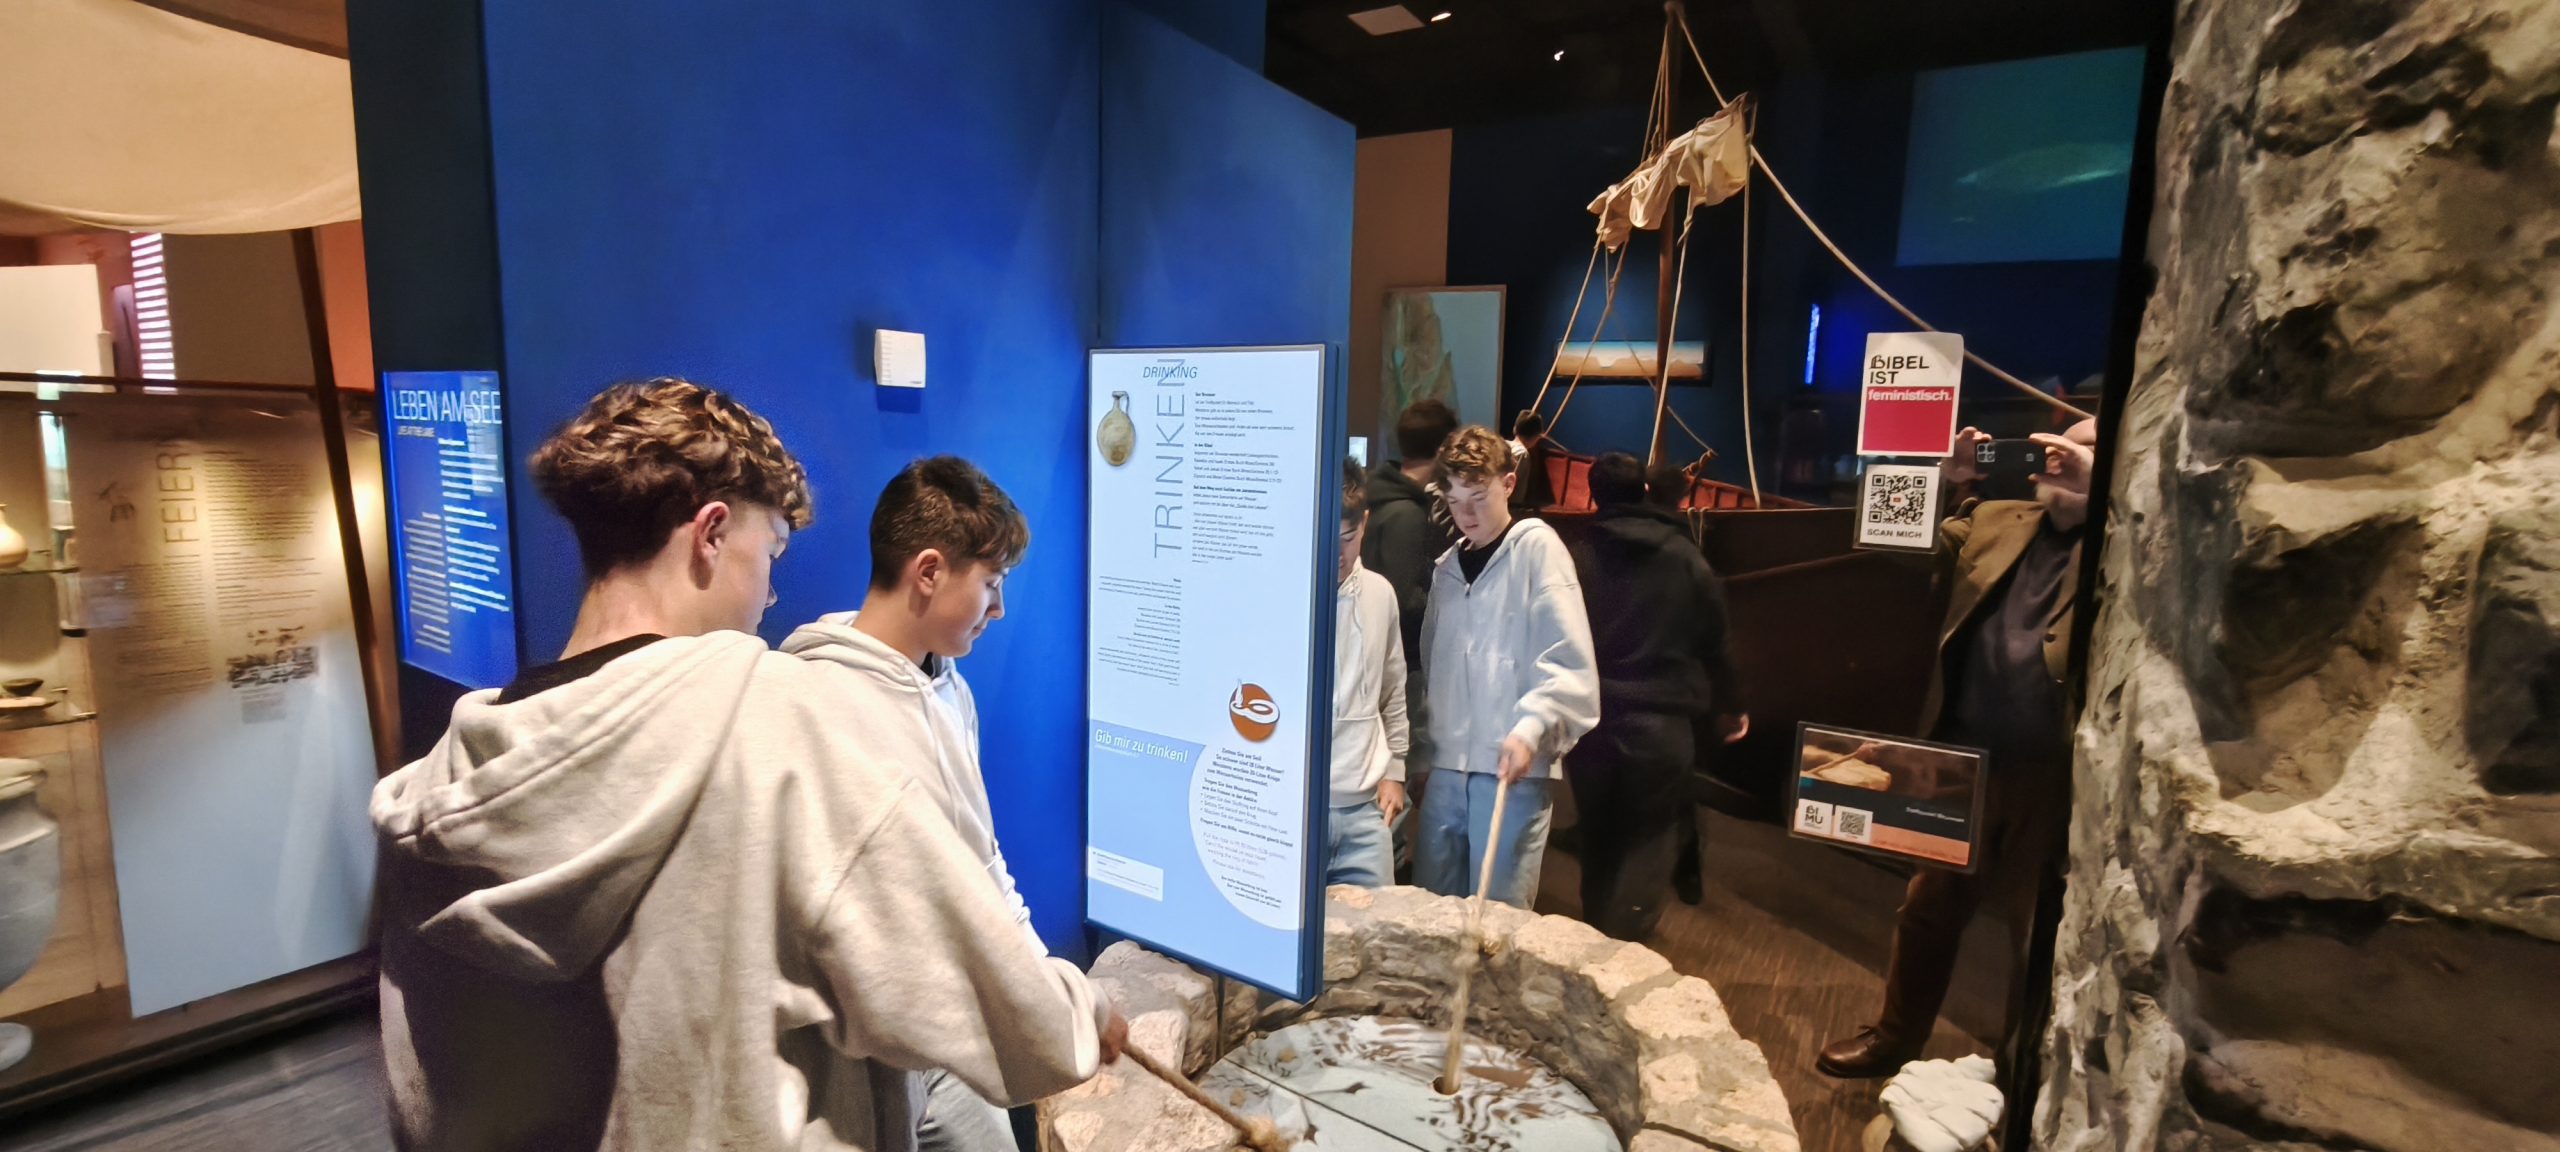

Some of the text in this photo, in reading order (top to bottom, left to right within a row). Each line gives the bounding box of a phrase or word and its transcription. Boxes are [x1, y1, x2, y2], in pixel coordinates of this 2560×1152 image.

[1869, 354, 1930, 370] BIBEL
[1143, 365, 1198, 380] DRINKING
[1869, 371, 1899, 385] IST
[1868, 388, 1953, 402] feministisch.
[392, 389, 503, 425] LEBEN AM SEE
[1154, 358, 1186, 559] TRINKEN
[1867, 528, 1922, 538] SCAN MICH
[1095, 728, 1112, 745] Gib
[1113, 735, 1130, 749] mir
[1131, 740, 1145, 753] zu
[1146, 742, 1189, 763] trinken!
[1806, 804, 1819, 815] BI
[1805, 813, 1824, 825] MU
